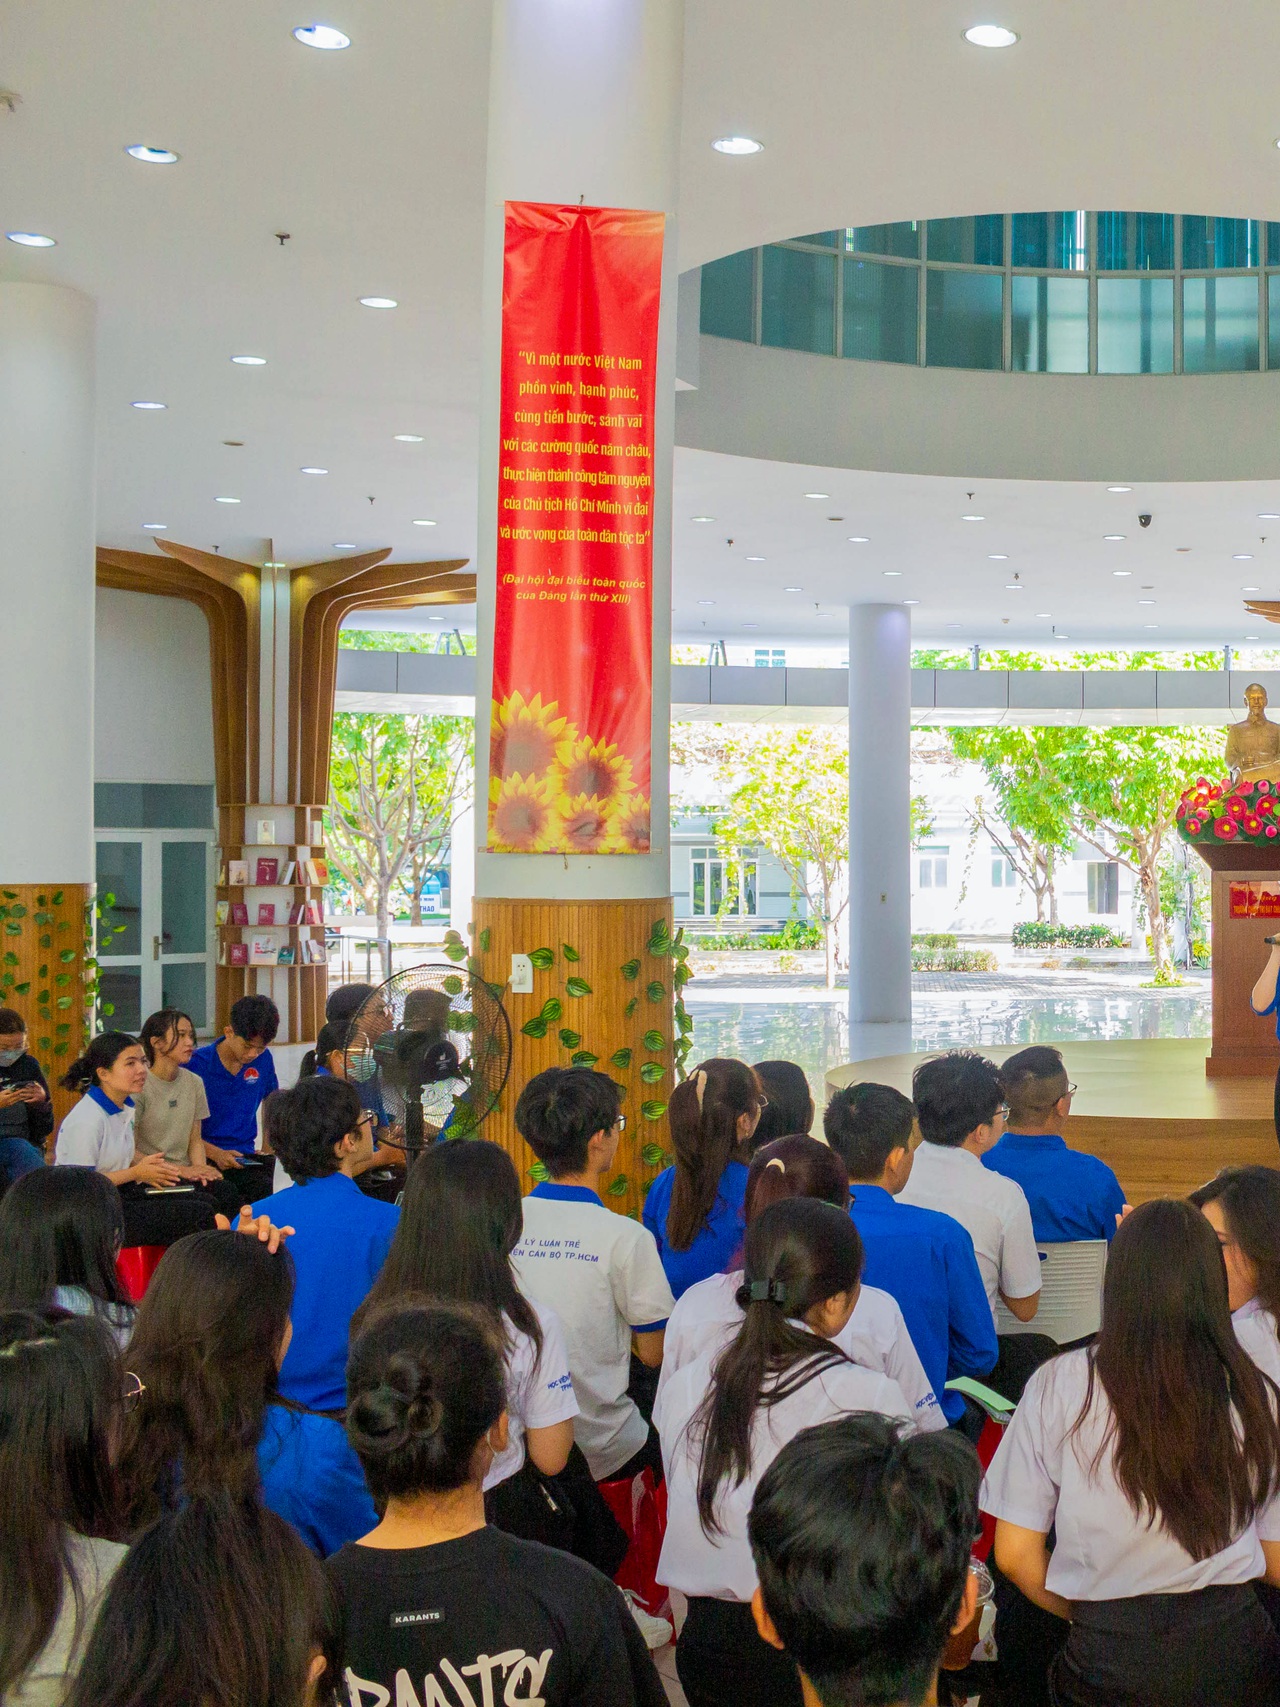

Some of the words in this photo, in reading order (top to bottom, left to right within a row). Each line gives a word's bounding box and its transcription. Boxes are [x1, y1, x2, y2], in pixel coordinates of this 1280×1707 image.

[539, 353, 560, 368] một
[564, 353, 591, 367] nước
[594, 355, 615, 370] Việt
[618, 357, 642, 369] Nam
[519, 381, 546, 396] phồn
[550, 382, 576, 396] vinh,
[580, 382, 606, 398] hạnh
[609, 385, 639, 400] phúc,
[515, 410, 540, 426] cùng
[544, 409, 563, 423] tiến
[567, 411, 596, 427] bước,
[600, 415, 624, 427] sánh
[627, 414, 642, 428] vai
[503, 438, 518, 451] với
[521, 439, 538, 452] các
[540, 439, 572, 455] cường
[575, 439, 599, 458] quốc
[601, 443, 622, 456] năm
[625, 444, 651, 458] châu,
[504, 467, 524, 483] thực
[526, 468, 546, 485] hiện
[548, 469, 574, 482] thành
[575, 470, 597, 486] công
[599, 471, 616, 485] tâm
[618, 473, 650, 488] nguyện
[504, 498, 520, 510] của
[524, 497, 542, 511] Chủ
[545, 498, 562, 513] tịch
[565, 496, 578, 511] Hồ
[580, 499, 595, 512] Chí
[598, 501, 621, 514] Minh
[624, 502, 632, 515] vĩ
[634, 502, 648, 517] đại
[500, 525, 510, 539] và
[512, 528, 531, 540] ước
[534, 529, 556, 543] vọng
[558, 527, 575, 540] của
[577, 528, 597, 542] toàn
[600, 530, 616, 543] dân
[619, 531, 633, 547] tộc
[503, 574, 523, 585] (Đại
[527, 575, 544, 586] hội
[547, 575, 562, 586] đại
[567, 574, 589, 586] biểu
[593, 578, 616, 588] toàn
[619, 577, 645, 589] quốc
[516, 591, 535, 599] của
[539, 590, 566, 602] Đảng
[570, 590, 586, 600] lần
[590, 592, 608, 602] thứ
[565, 1252, 599, 1262] TP.HCM
[395, 1612, 440, 1623] KARANTS
